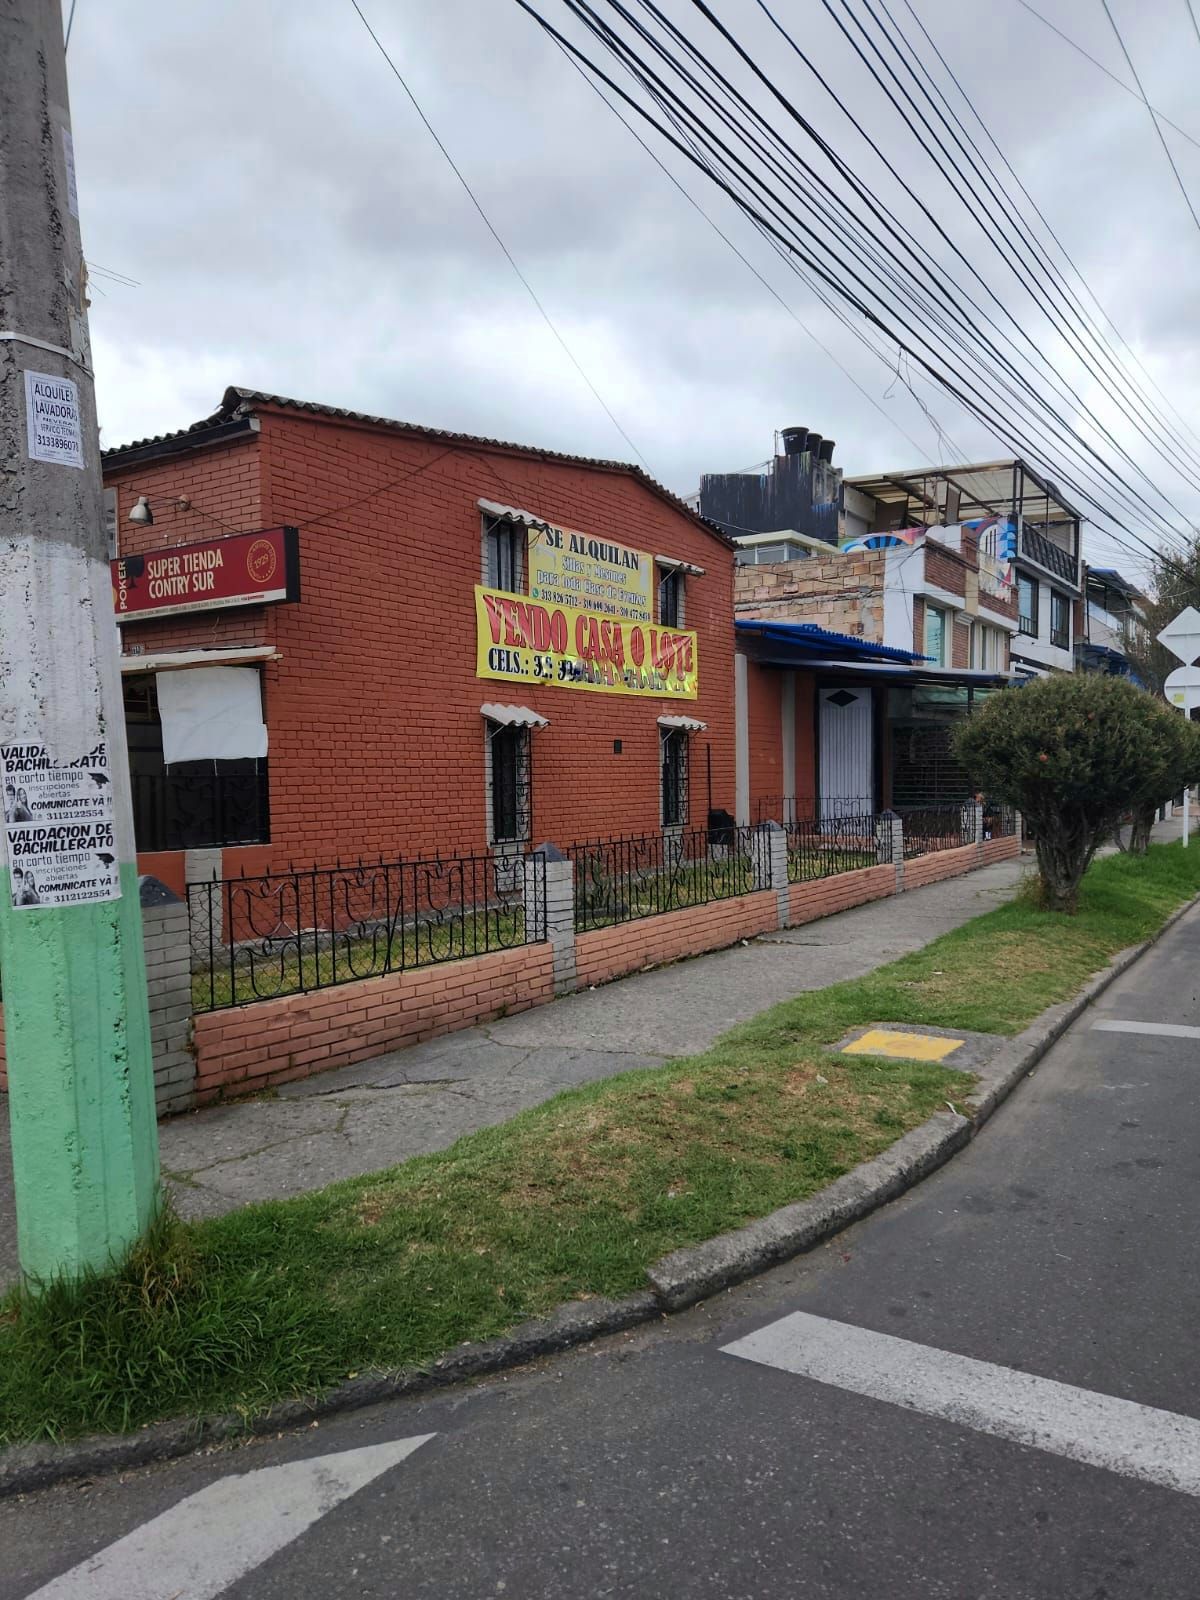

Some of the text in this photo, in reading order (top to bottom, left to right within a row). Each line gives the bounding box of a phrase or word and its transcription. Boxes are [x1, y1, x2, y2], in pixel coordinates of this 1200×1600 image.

[545, 527, 639, 570] SE ALQUILAN
[147, 556, 180, 580] SUPER
[182, 549, 223, 572] TIENDA
[254, 553, 269, 569] 1929
[118, 560, 128, 610] POKER
[148, 571, 215, 599] CONTRY SUR
[537, 569, 560, 587] para
[483, 594, 568, 655] VENDO
[575, 614, 625, 671] CASA
[630, 625, 645, 667] O
[649, 628, 694, 681] LOTE
[5, 776, 16, 785] en
[48, 770, 84, 783] tiempo
[28, 782, 80, 791] inscripciones
[38, 791, 71, 799] abiertas
[31, 798, 90, 811] COMUNICATE
[46, 809, 104, 820] 3112122554
[8, 823, 112, 843] VALIDACION DE
[13, 835, 114, 856] BACHILLERATO
[12, 859, 24, 868] en
[55, 852, 91, 865] tiempo
[35, 864, 87, 875] inscripciones
[45, 872, 78, 882] abiertas
[38, 878, 97, 893] COMUNICATE
[54, 889, 111, 902] 3112122554
